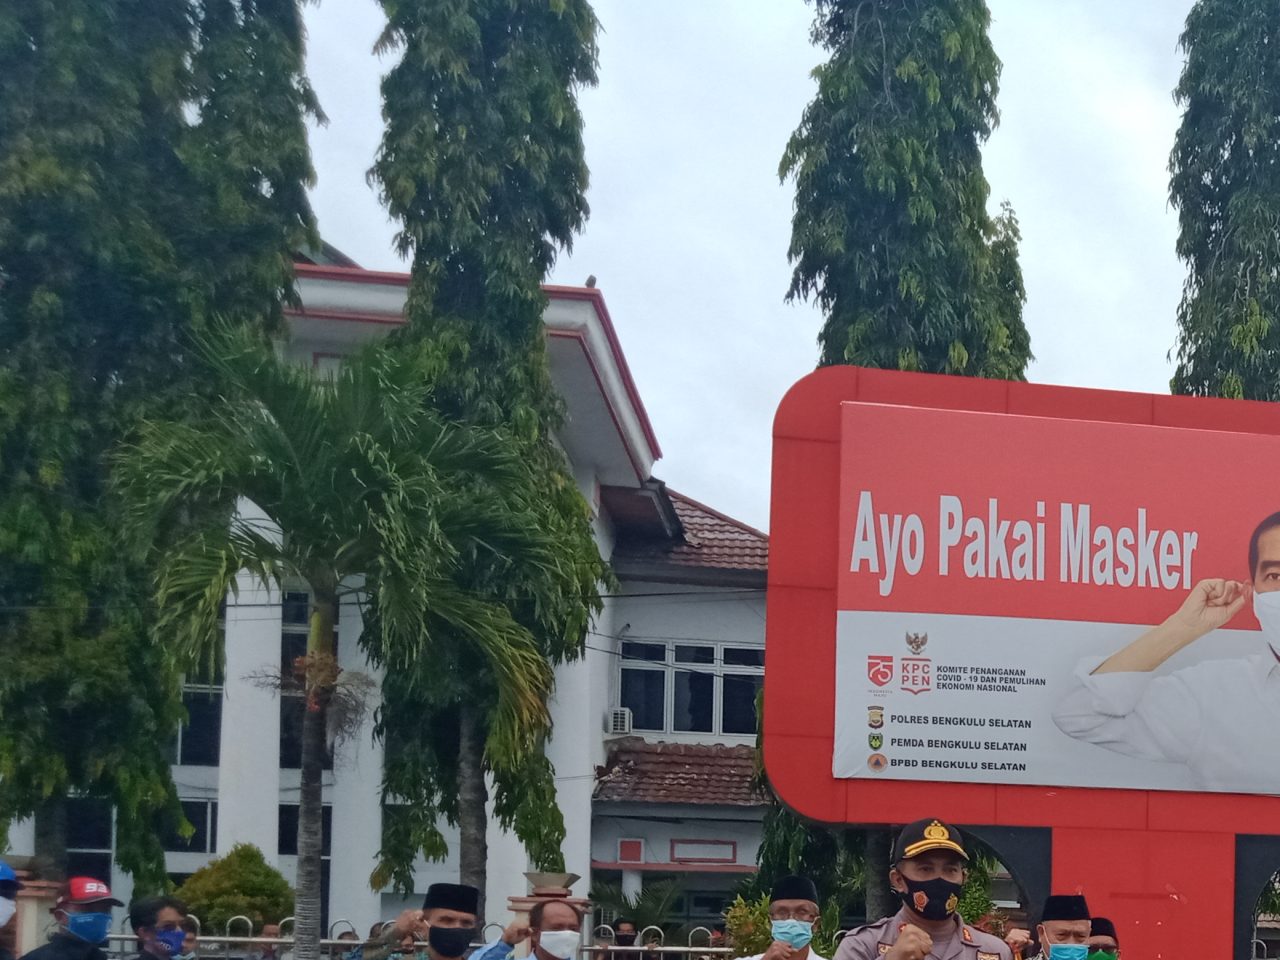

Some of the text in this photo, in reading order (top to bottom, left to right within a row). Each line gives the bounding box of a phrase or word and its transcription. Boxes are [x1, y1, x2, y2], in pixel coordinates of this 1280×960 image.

[850, 491, 1199, 597] Ayo Pakai Masker
[901, 663, 930, 674] KPC
[936, 665, 1026, 676] KOMITE PENANGANAN
[901, 675, 930, 686] PEN
[936, 674, 962, 682] COVID
[969, 675, 978, 683] 19
[980, 676, 997, 684] DAN
[999, 676, 1046, 686] PEMULIHAN
[936, 682, 1018, 693] EKONOMI NASIONAL
[890, 714, 1032, 729] POLRES BENGKULU SELATAN
[890, 738, 1027, 752] PEMDA BENGKULU SELATAN
[890, 758, 1026, 772] BPBD BENGKULU SELATAN
